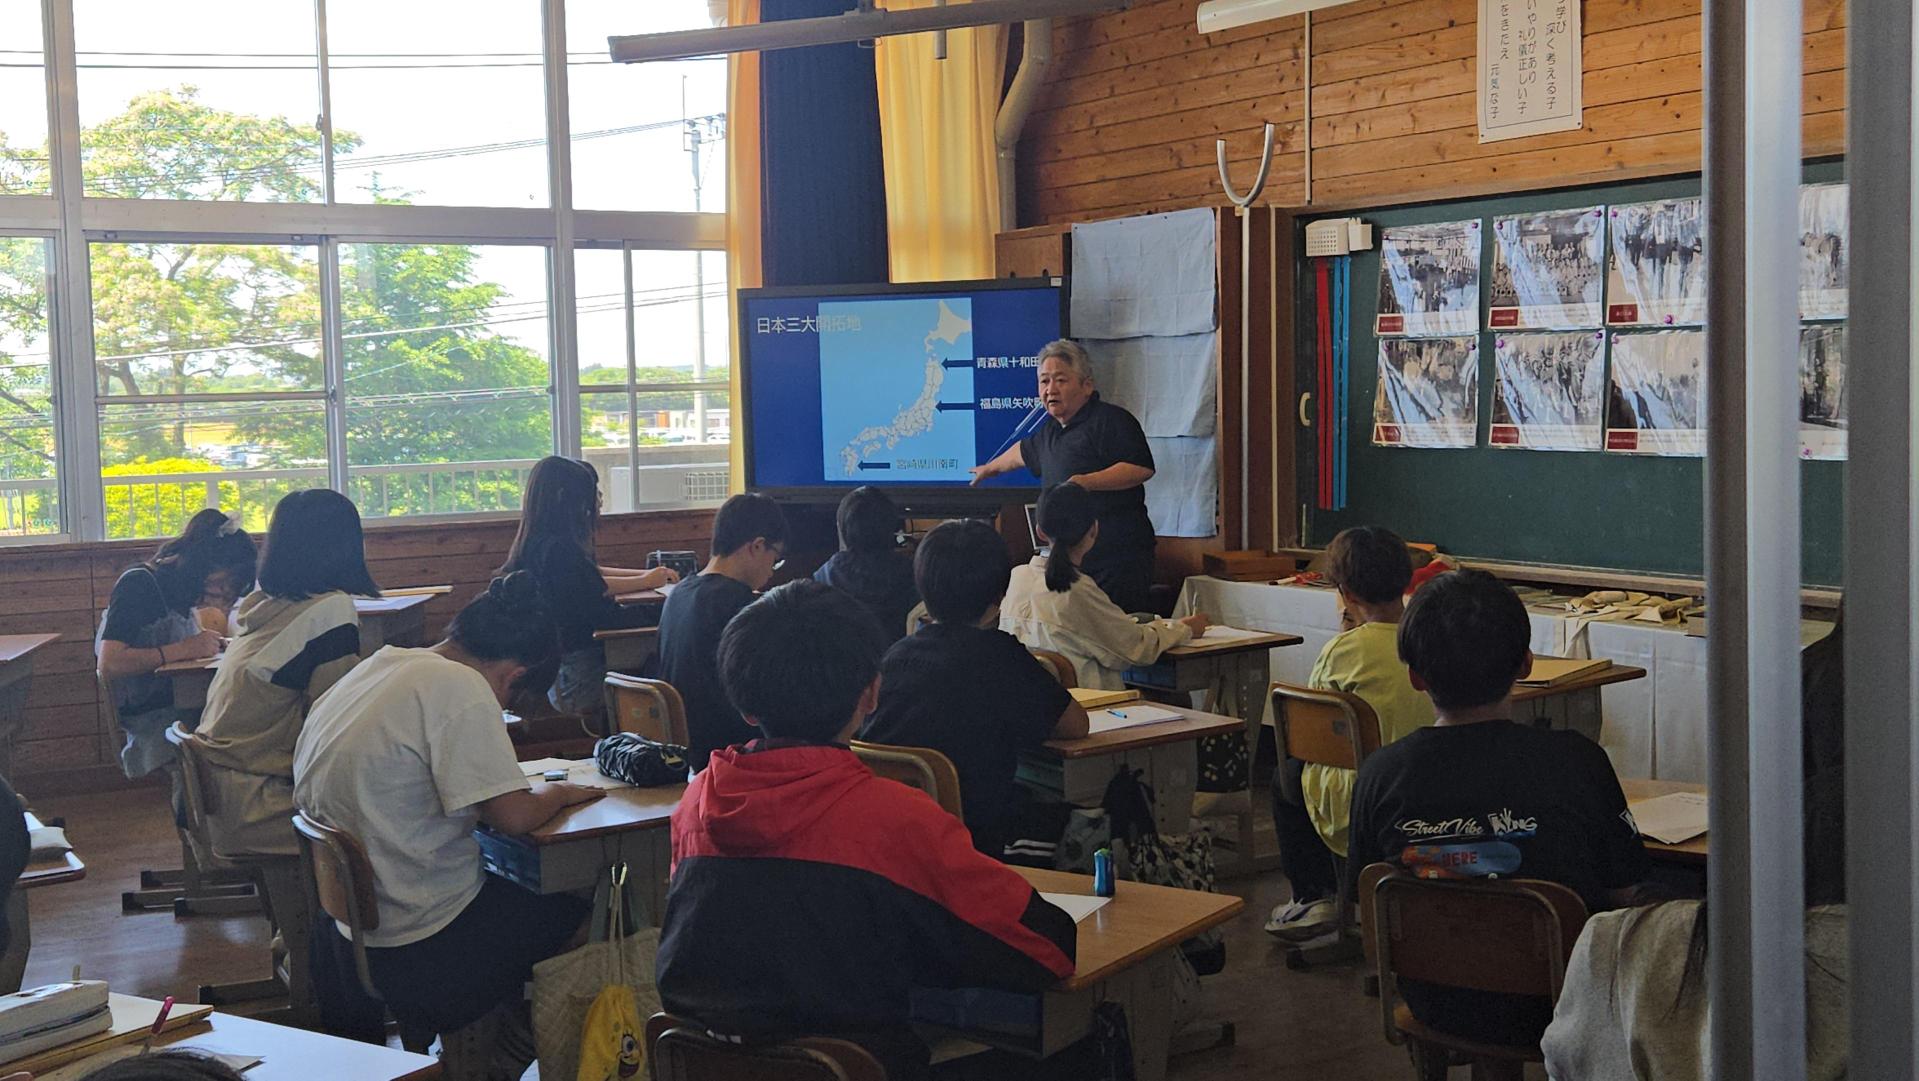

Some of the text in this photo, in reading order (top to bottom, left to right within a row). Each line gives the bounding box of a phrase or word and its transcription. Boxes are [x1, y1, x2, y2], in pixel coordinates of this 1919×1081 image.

[1555, 0, 1566, 34] 学び
[1500, 0, 1509, 60] をきたえ
[757, 315, 862, 334] 日本三大開拓地
[976, 356, 1040, 369] 青森県十和田
[1402, 819, 1446, 836] Street
[1444, 818, 1485, 836] Vibe
